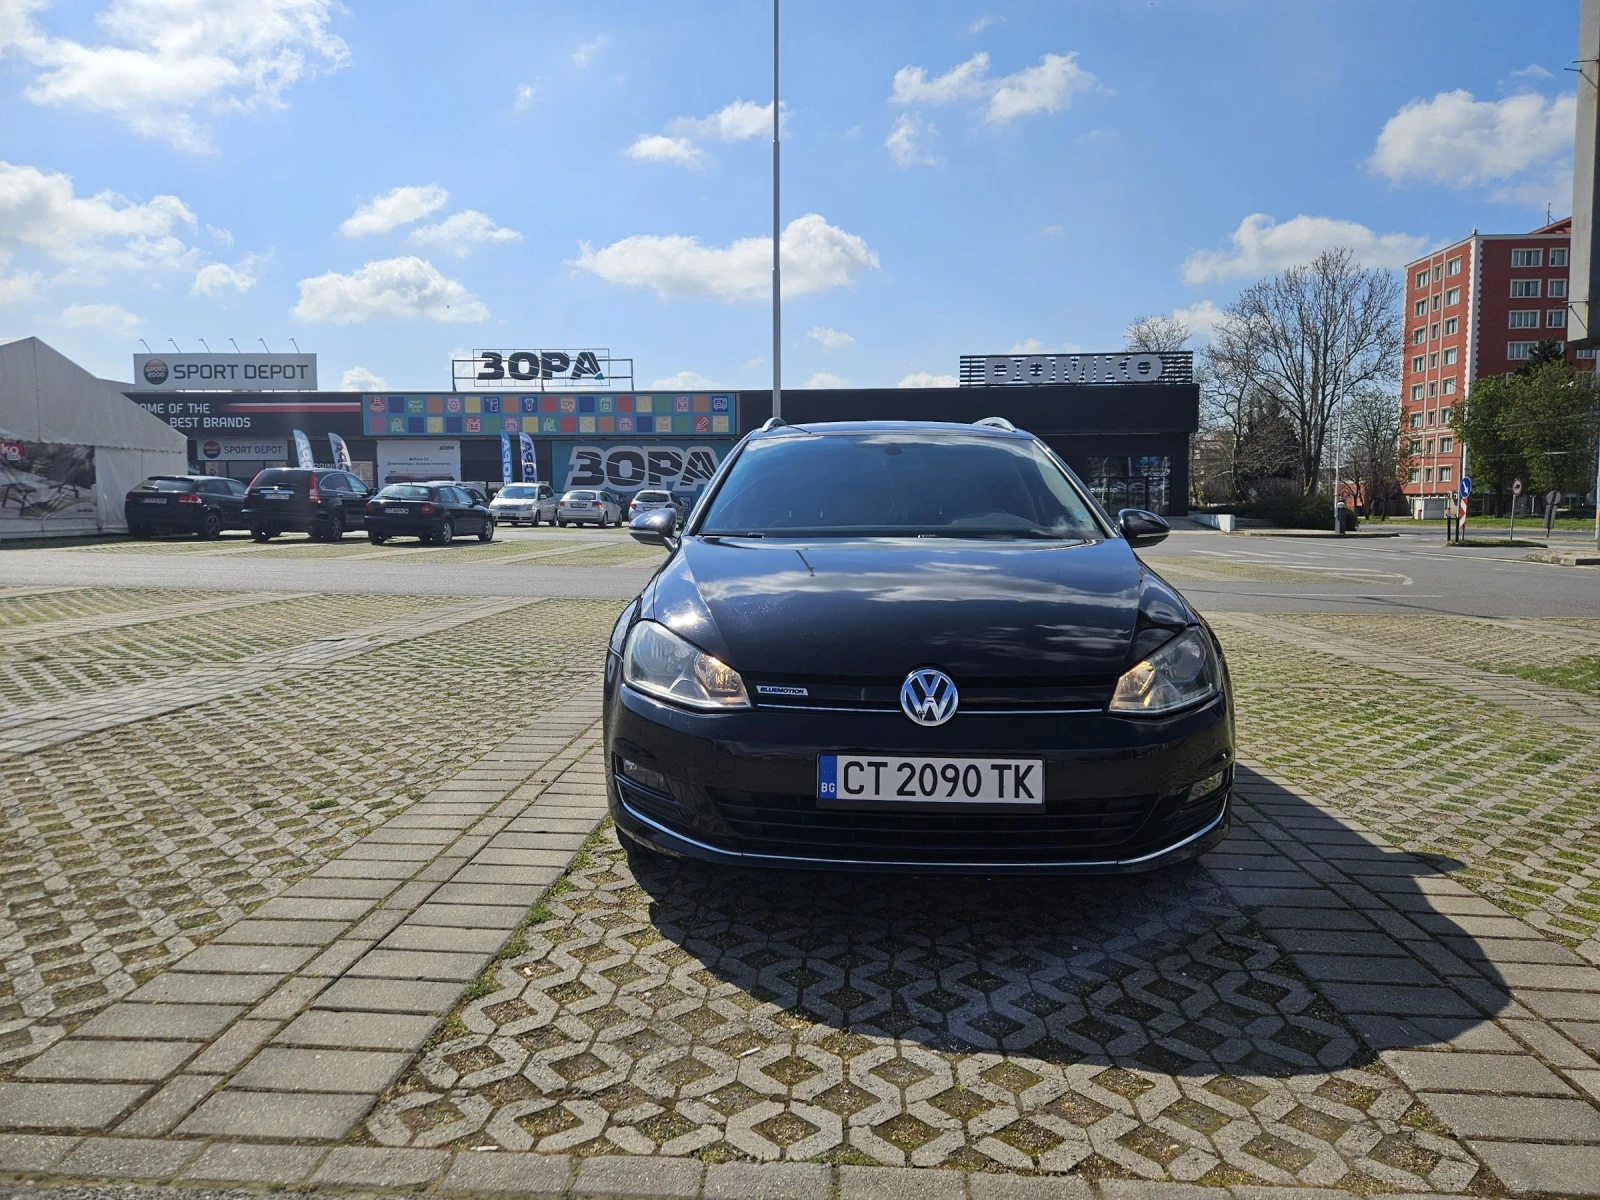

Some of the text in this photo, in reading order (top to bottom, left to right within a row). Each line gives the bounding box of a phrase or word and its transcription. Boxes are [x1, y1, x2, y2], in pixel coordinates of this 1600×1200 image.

[174, 364, 308, 379] SPORT DEPOT
[477, 352, 604, 380] ЗОРА
[984, 354, 1162, 383] DOMKO
[139, 403, 210, 414] OME OF THE
[170, 418, 250, 428] BEST BRANDS
[224, 446, 282, 454] SPORT DEPOT
[566, 448, 719, 489] ЗОРА
[904, 671, 957, 724] VW
[822, 782, 835, 792] BG
[844, 761, 1034, 798] CT 2090 TK
